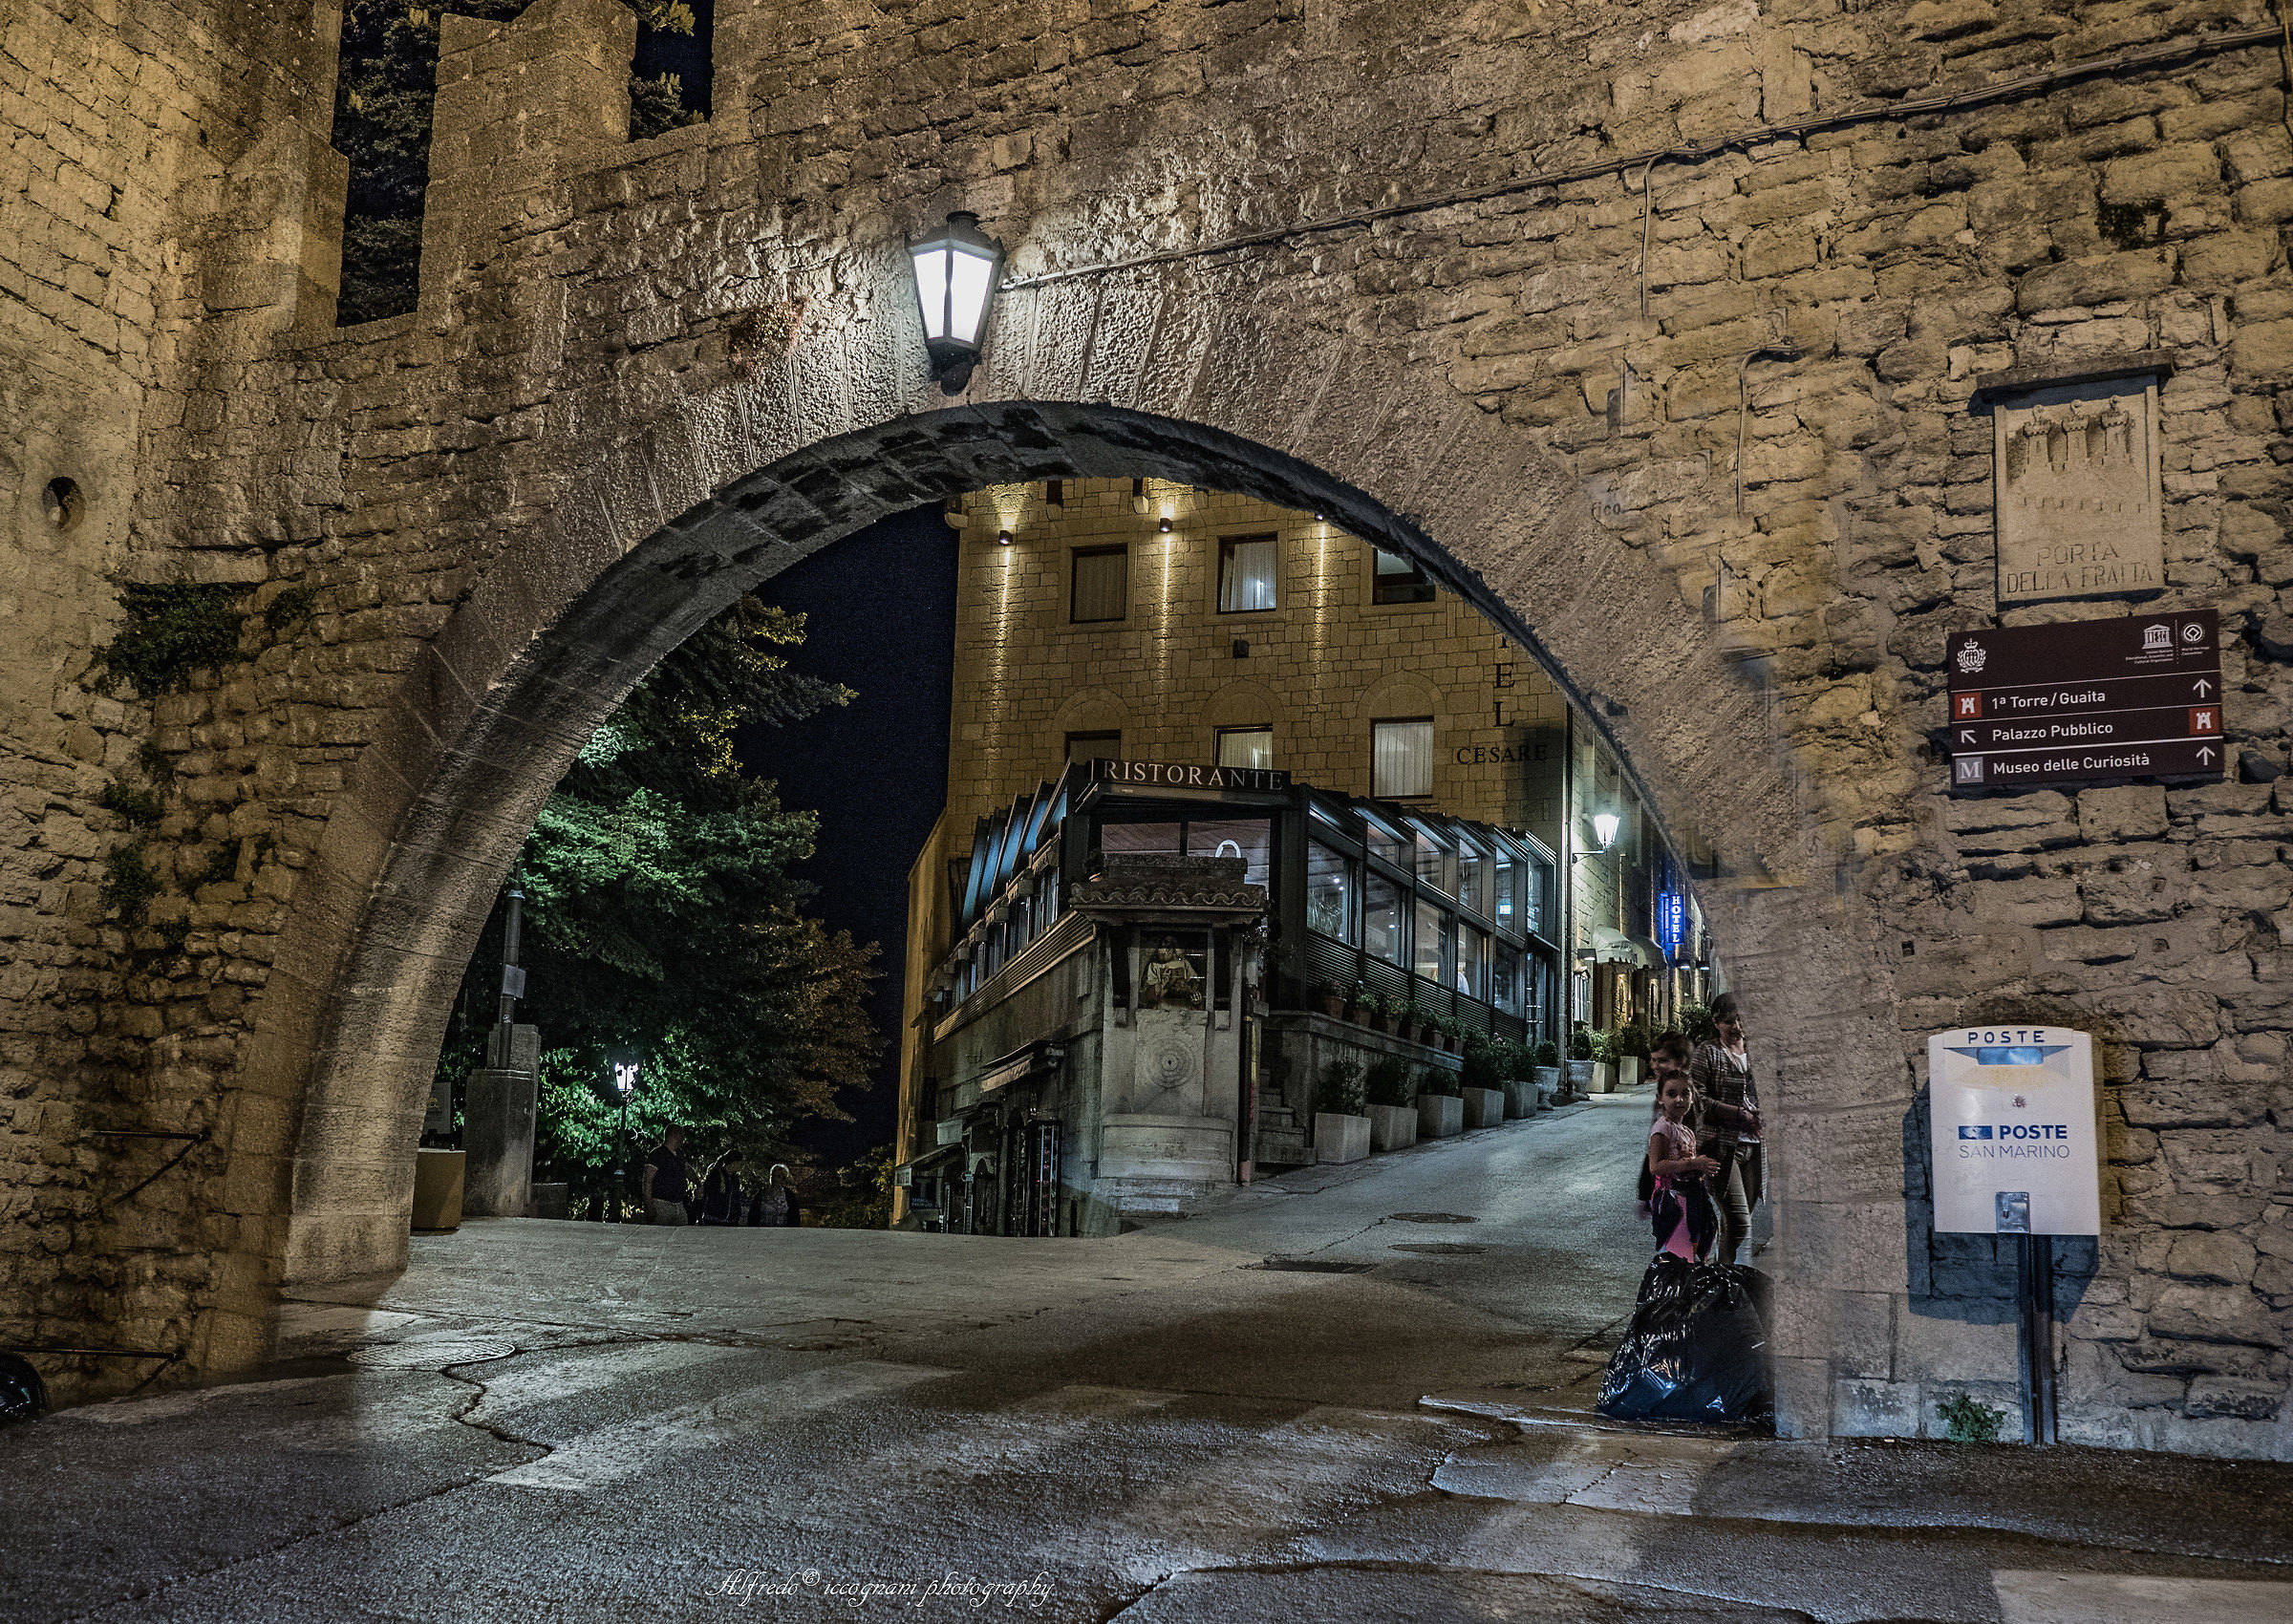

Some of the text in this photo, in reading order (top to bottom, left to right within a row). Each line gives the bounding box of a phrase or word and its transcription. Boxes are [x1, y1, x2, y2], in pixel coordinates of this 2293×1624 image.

[2037, 543, 2119, 566] PORTA
[2006, 562, 2154, 593] DELLA FRATTA
[1992, 721, 2113, 742] Palazzo Pubblico
[1457, 745, 1547, 764] CESARE
[1993, 753, 2150, 776] Museo delle Curiosità
[1104, 760, 1283, 791] RISTORANTE
[1672, 895, 1682, 943] HOTEL
[1967, 1030, 2046, 1044] POSTE
[2000, 1124, 2068, 1140] POSTE
[1959, 1144, 2070, 1159] SAN MARINO
